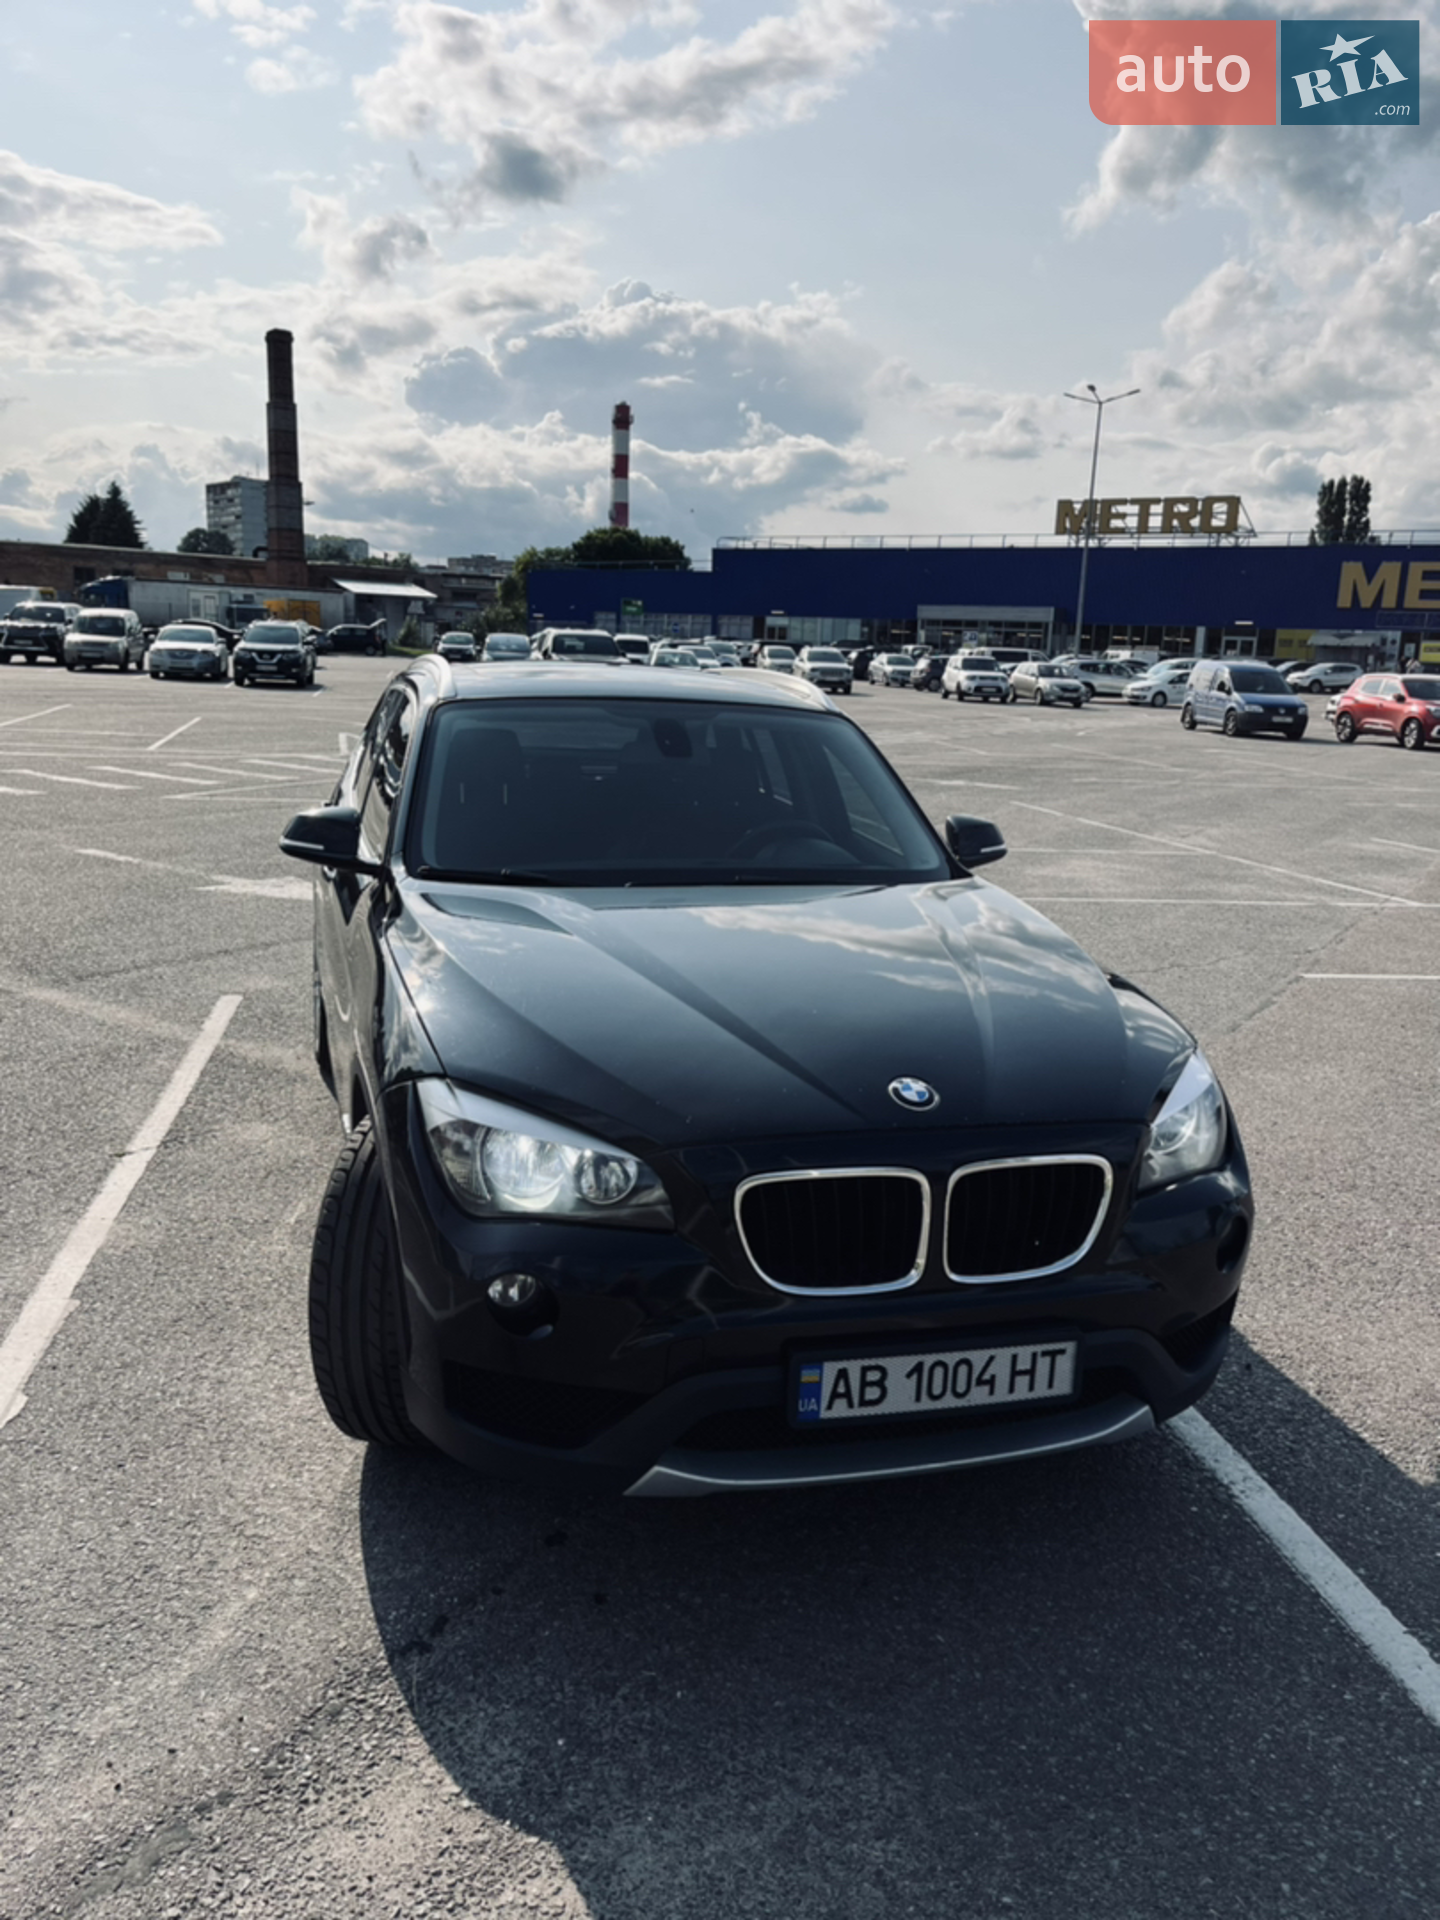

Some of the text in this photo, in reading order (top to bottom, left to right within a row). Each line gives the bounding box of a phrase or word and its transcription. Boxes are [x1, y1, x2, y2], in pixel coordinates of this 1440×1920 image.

[1055, 496, 1240, 534] METRO
[1336, 561, 1440, 608] ME
[826, 1349, 1067, 1410] AB 1004 HT
[798, 1397, 818, 1412] UA
